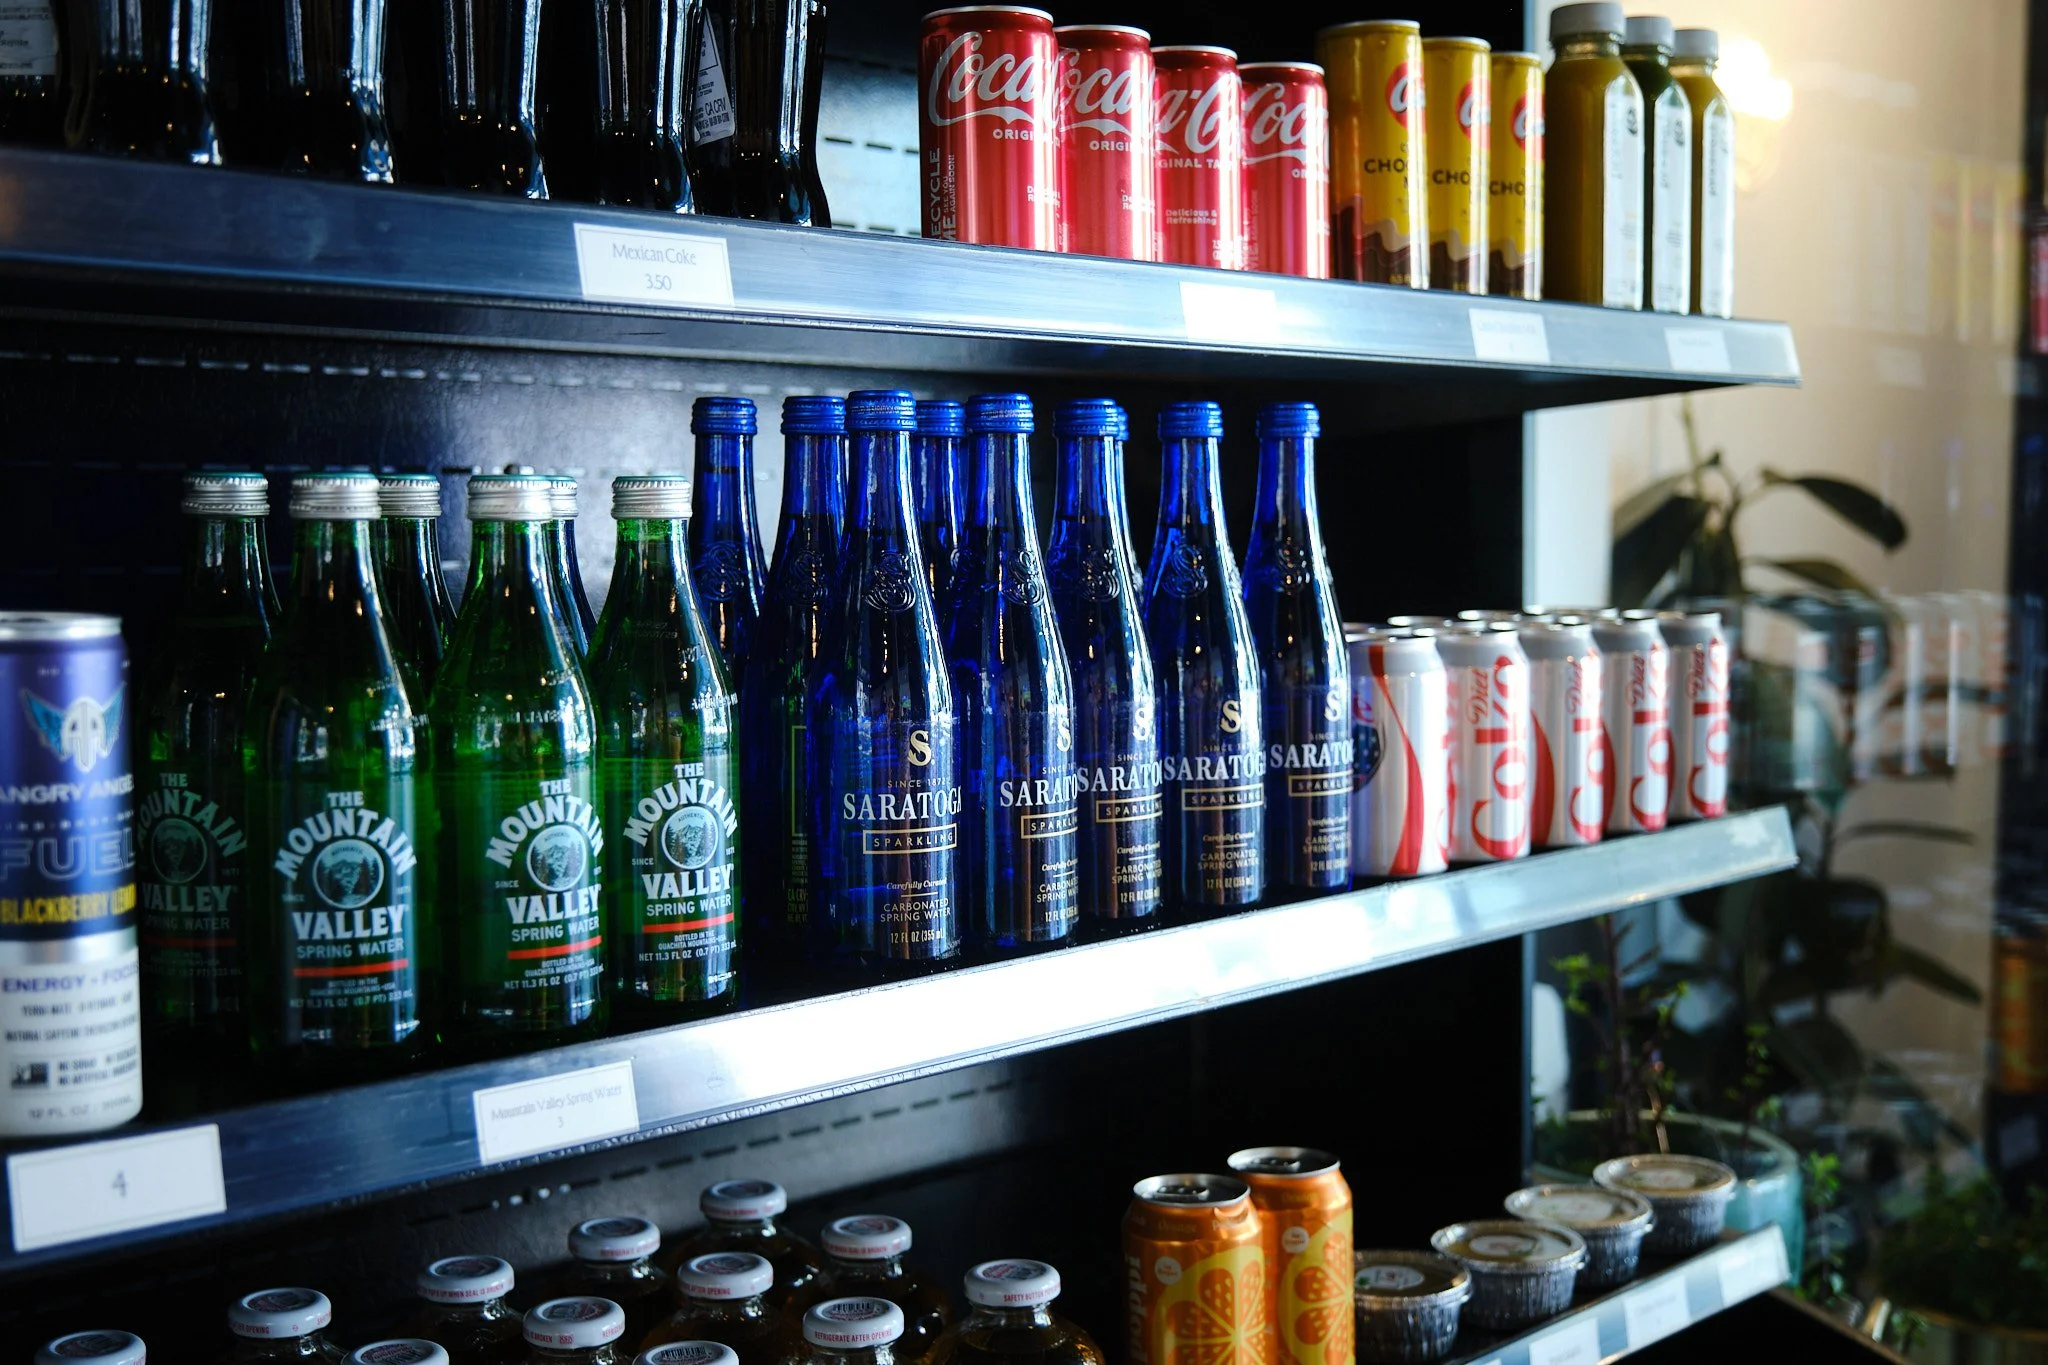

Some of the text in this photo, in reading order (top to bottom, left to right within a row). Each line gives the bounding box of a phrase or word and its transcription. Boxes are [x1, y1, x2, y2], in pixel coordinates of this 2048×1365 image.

[948, 184, 957, 212] AGAIN
[612, 242, 697, 266] Mexican Coke
[1467, 669, 1488, 725] Diet
[1220, 699, 1242, 734] S
[1057, 717, 1072, 752] S
[907, 730, 932, 766] S
[1117, 753, 1143, 762] SINCE
[674, 762, 704, 778] THE
[160, 772, 188, 787] THE
[539, 778, 571, 796] THE
[887, 780, 921, 789] SINCE
[0, 784, 84, 804] ANGRY
[1000, 774, 1078, 807] SARATO
[1191, 791, 1261, 804] SPARKLING
[327, 791, 364, 807] THE
[622, 778, 738, 848] MOUNTAIN
[137, 788, 248, 858] MOUNTAIN
[485, 795, 604, 869] MOUNTAIN
[874, 832, 953, 847] SPARKLING
[274, 808, 418, 881] MOUNTAIN
[0, 827, 136, 881] FUEL
[632, 857, 655, 866] SINCE
[1200, 849, 1256, 861] CARBONATED
[1198, 857, 1259, 870] SPRING WATER
[495, 880, 519, 889] SINCE
[641, 864, 732, 899] VALLEY
[886, 880, 922, 890] Carefully
[1112, 873, 1143, 884] SPRING
[142, 884, 232, 913] VALLEY
[506, 884, 602, 925] VALLEY
[883, 898, 949, 912] CARBONATED
[1036, 891, 1066, 903] SPRING
[1121, 891, 1135, 903] 12 FL
[646, 894, 731, 917] SPRING WATER
[292, 904, 406, 940] VALLEY
[880, 907, 951, 923] SPRING WATER
[1045, 911, 1052, 923] 12
[184, 917, 230, 930] WATER
[511, 916, 600, 942] SPRING WATER
[674, 932, 698, 942] BOTTLED
[891, 933, 898, 944] 12
[901, 932, 908, 943] FL
[911, 931, 919, 942] OZ
[297, 937, 404, 959] SPRING WATER
[639, 952, 653, 961] NET
[655, 951, 669, 961] 11.3
[671, 950, 680, 960] FL
[682, 949, 692, 959] OZ
[696, 947, 709, 958] (0.7
[710, 945, 720, 955] PT)
[658, 941, 686, 951] OUACHITA
[3, 974, 86, 994] ENERGY
[504, 980, 519, 990] NET
[539, 978, 548, 987] FL
[550, 976, 561, 985] OZ
[491, 1084, 622, 1121] Mountain Valley Spring Water
[558, 1116, 564, 1128] 3
[111, 1170, 127, 1198] 4
[1004, 1292, 1023, 1303] SAFETY
[815, 1330, 893, 1343] REFRIGERATE AFTER OPENING
